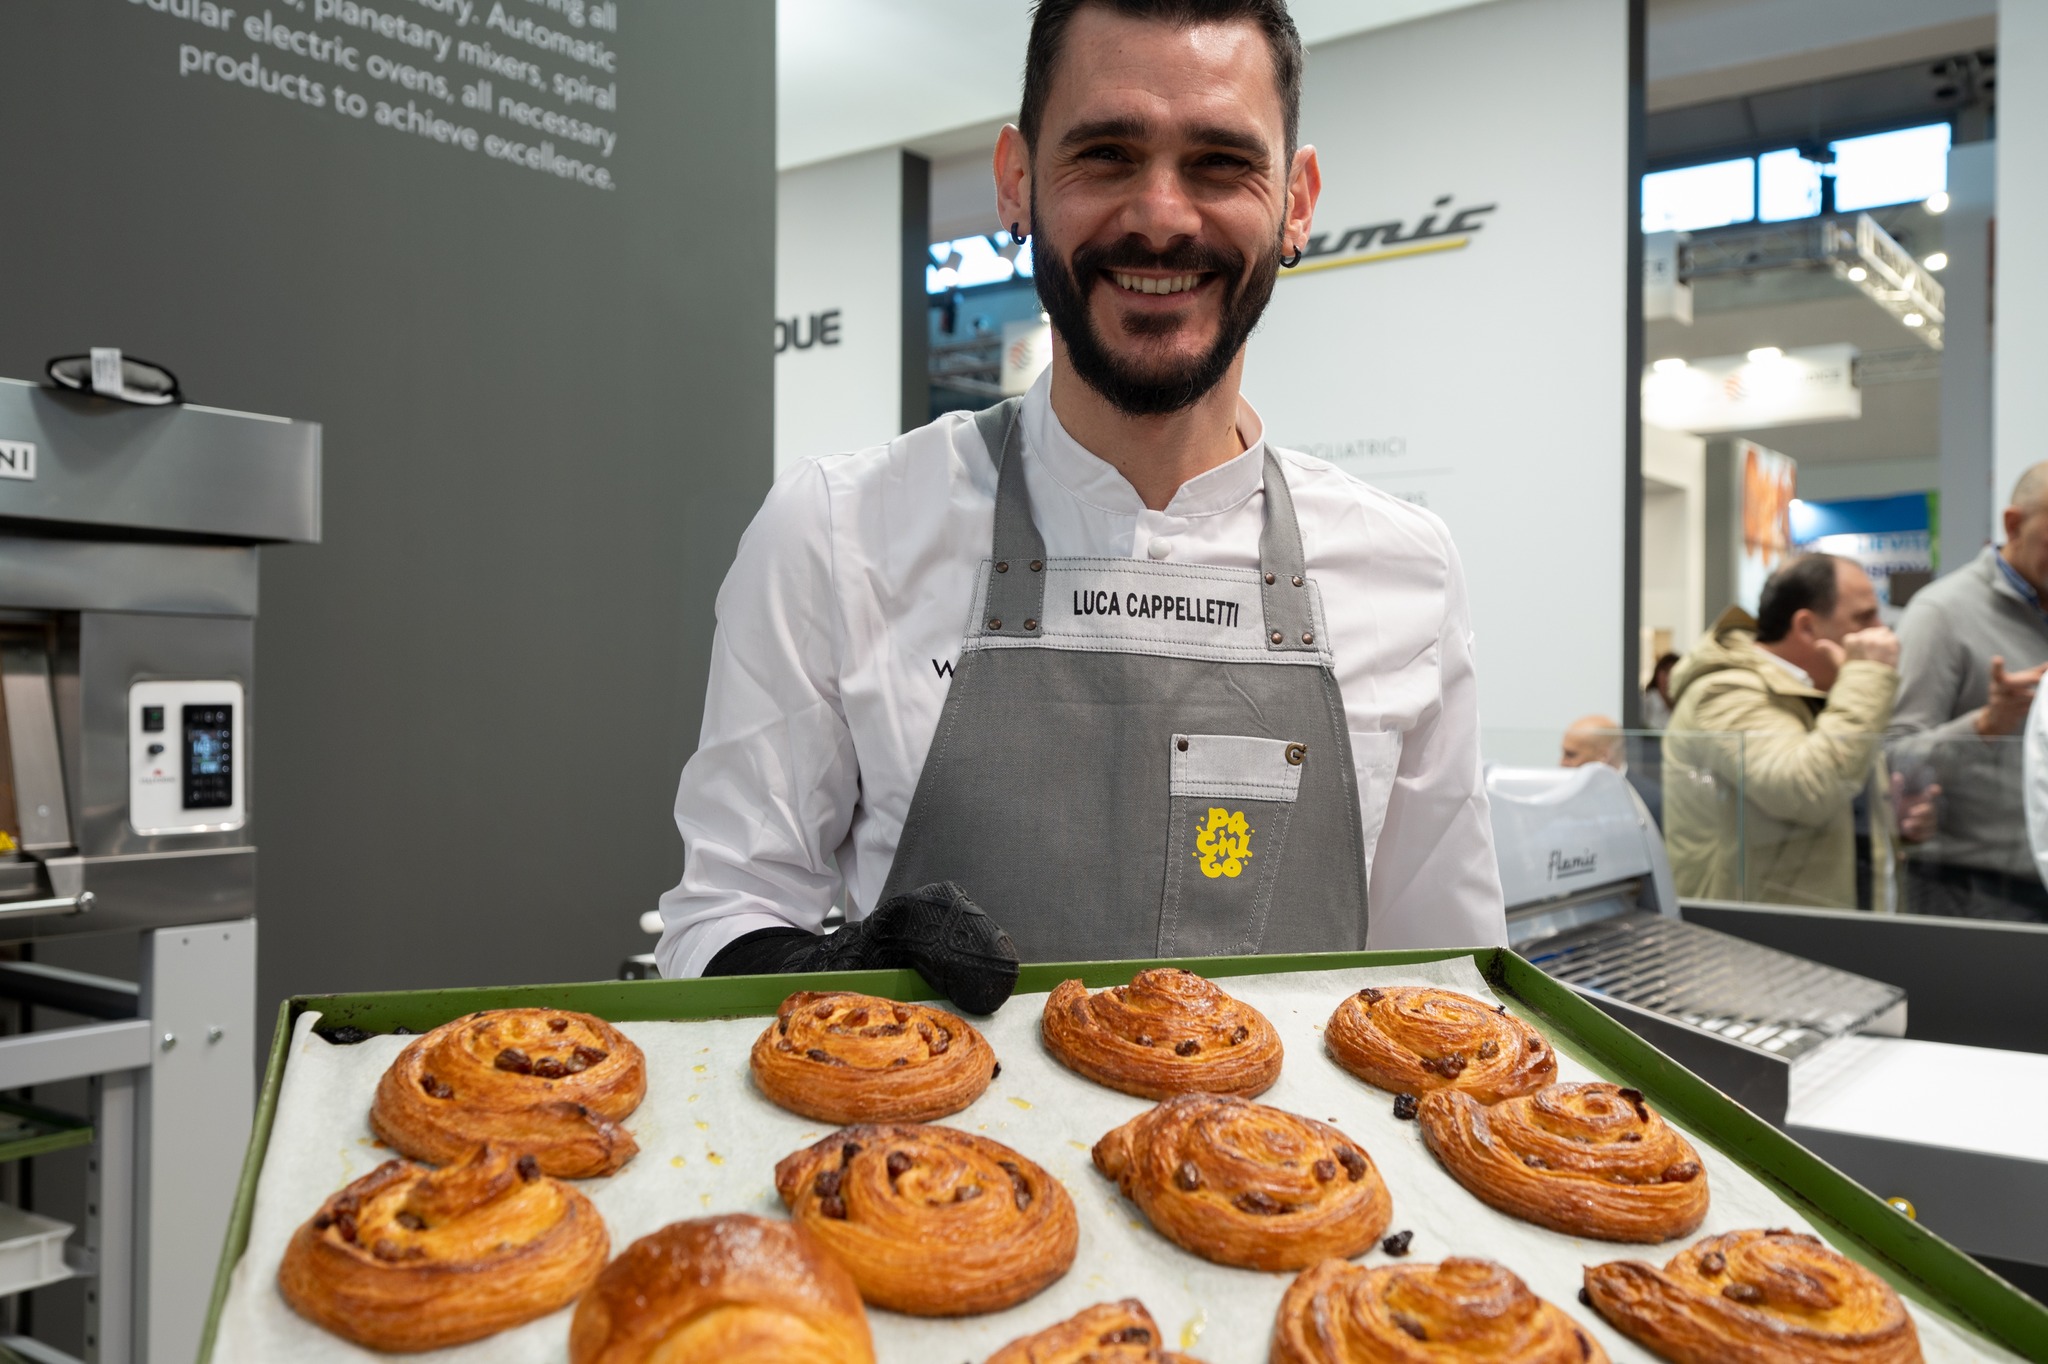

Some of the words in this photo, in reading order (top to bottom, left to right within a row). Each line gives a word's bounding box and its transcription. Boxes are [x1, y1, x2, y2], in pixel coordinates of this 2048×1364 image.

[314, 0, 452, 62] planetary
[457, 40, 547, 92] mixers,
[552, 73, 617, 111] spiral
[485, 2, 617, 73] Automatic
[588, 1, 617, 33] all
[179, 43, 326, 107] products
[332, 85, 368, 118] to
[374, 99, 479, 151] achieve
[483, 134, 616, 191] excellence.
[243, 9, 360, 71] electric
[366, 55, 455, 104] ovens,
[461, 79, 492, 113] all
[499, 96, 617, 157] necessary
[1073, 590, 1121, 616] LUCA
[1126, 592, 1239, 628] CAPPELLETTI
